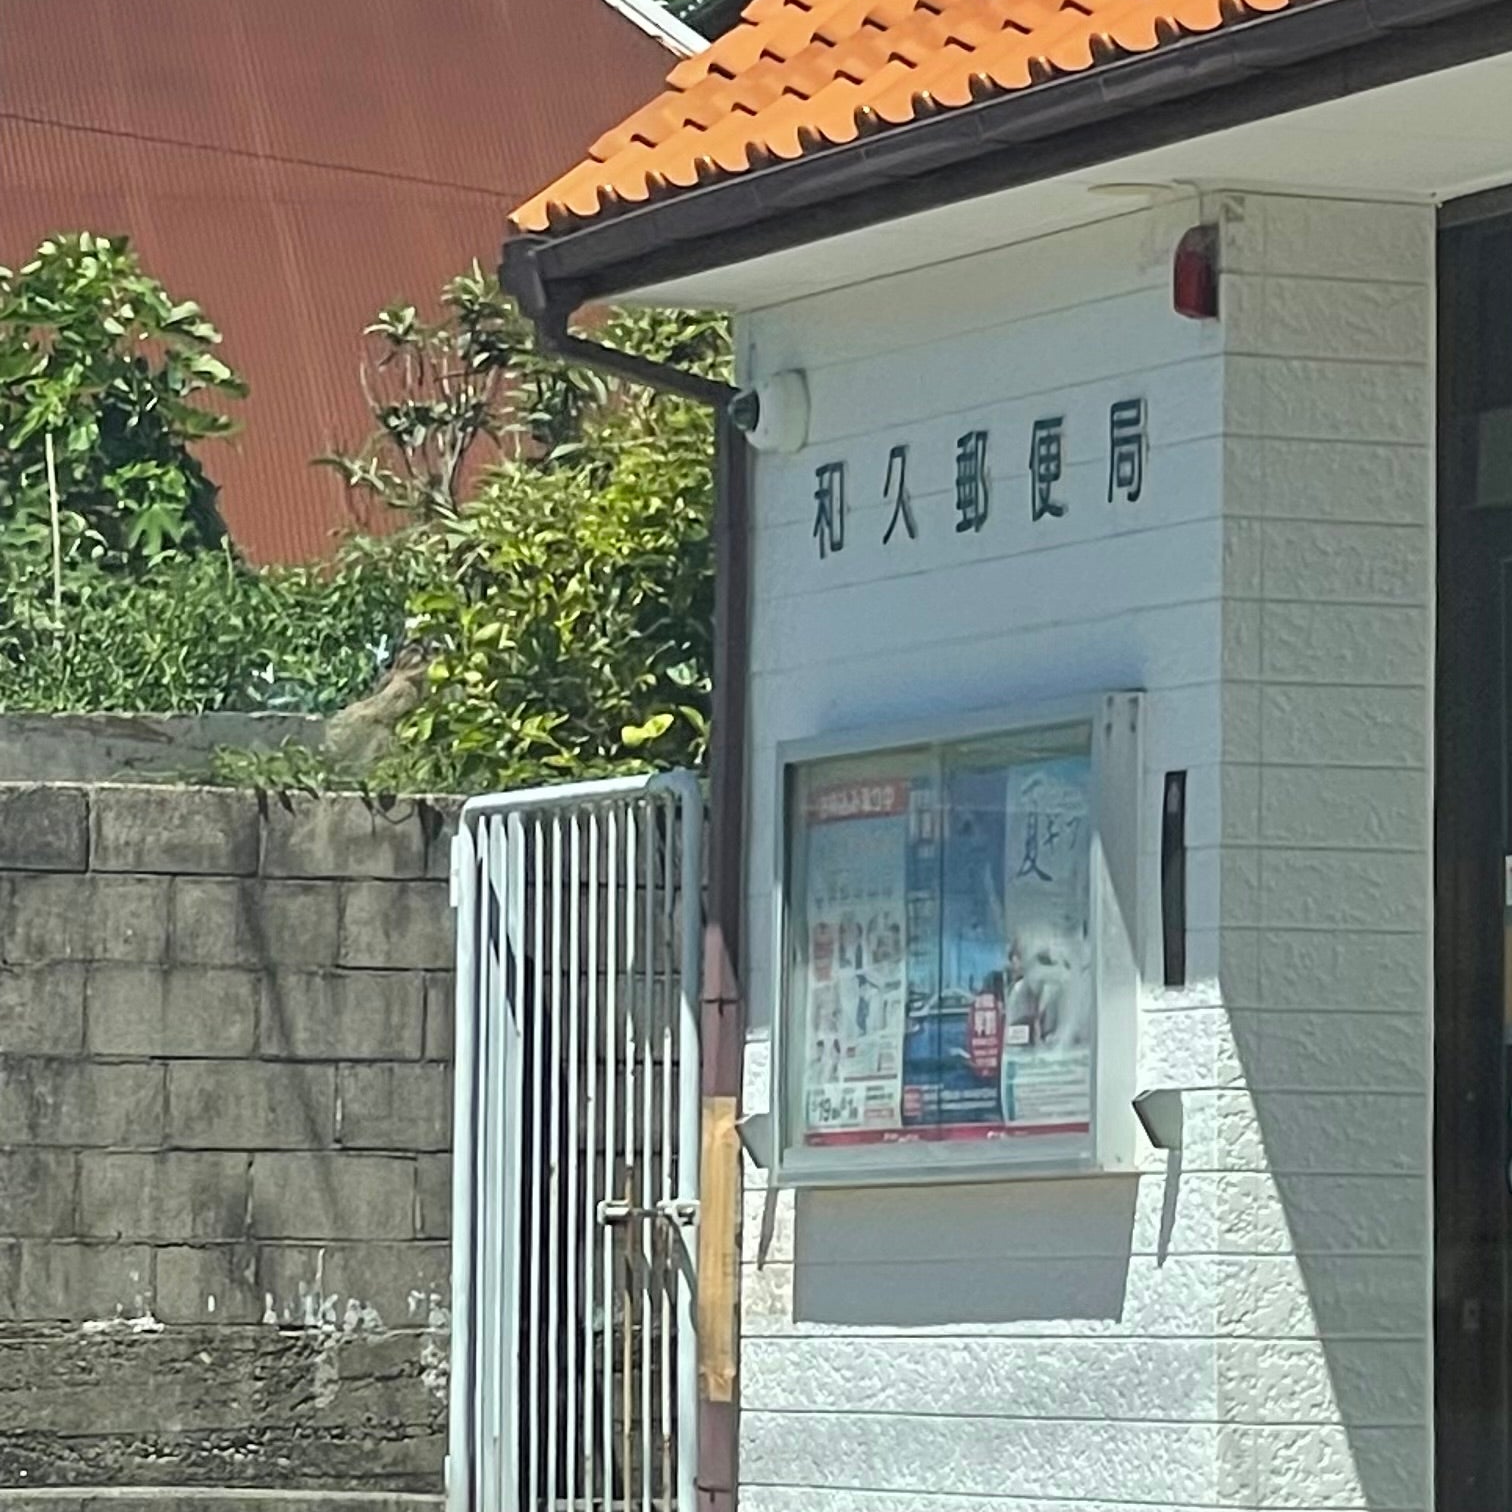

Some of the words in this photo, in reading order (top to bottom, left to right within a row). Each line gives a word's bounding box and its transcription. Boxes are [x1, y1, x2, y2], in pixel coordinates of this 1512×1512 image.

[813, 397, 1149, 559] 和久郵便局
